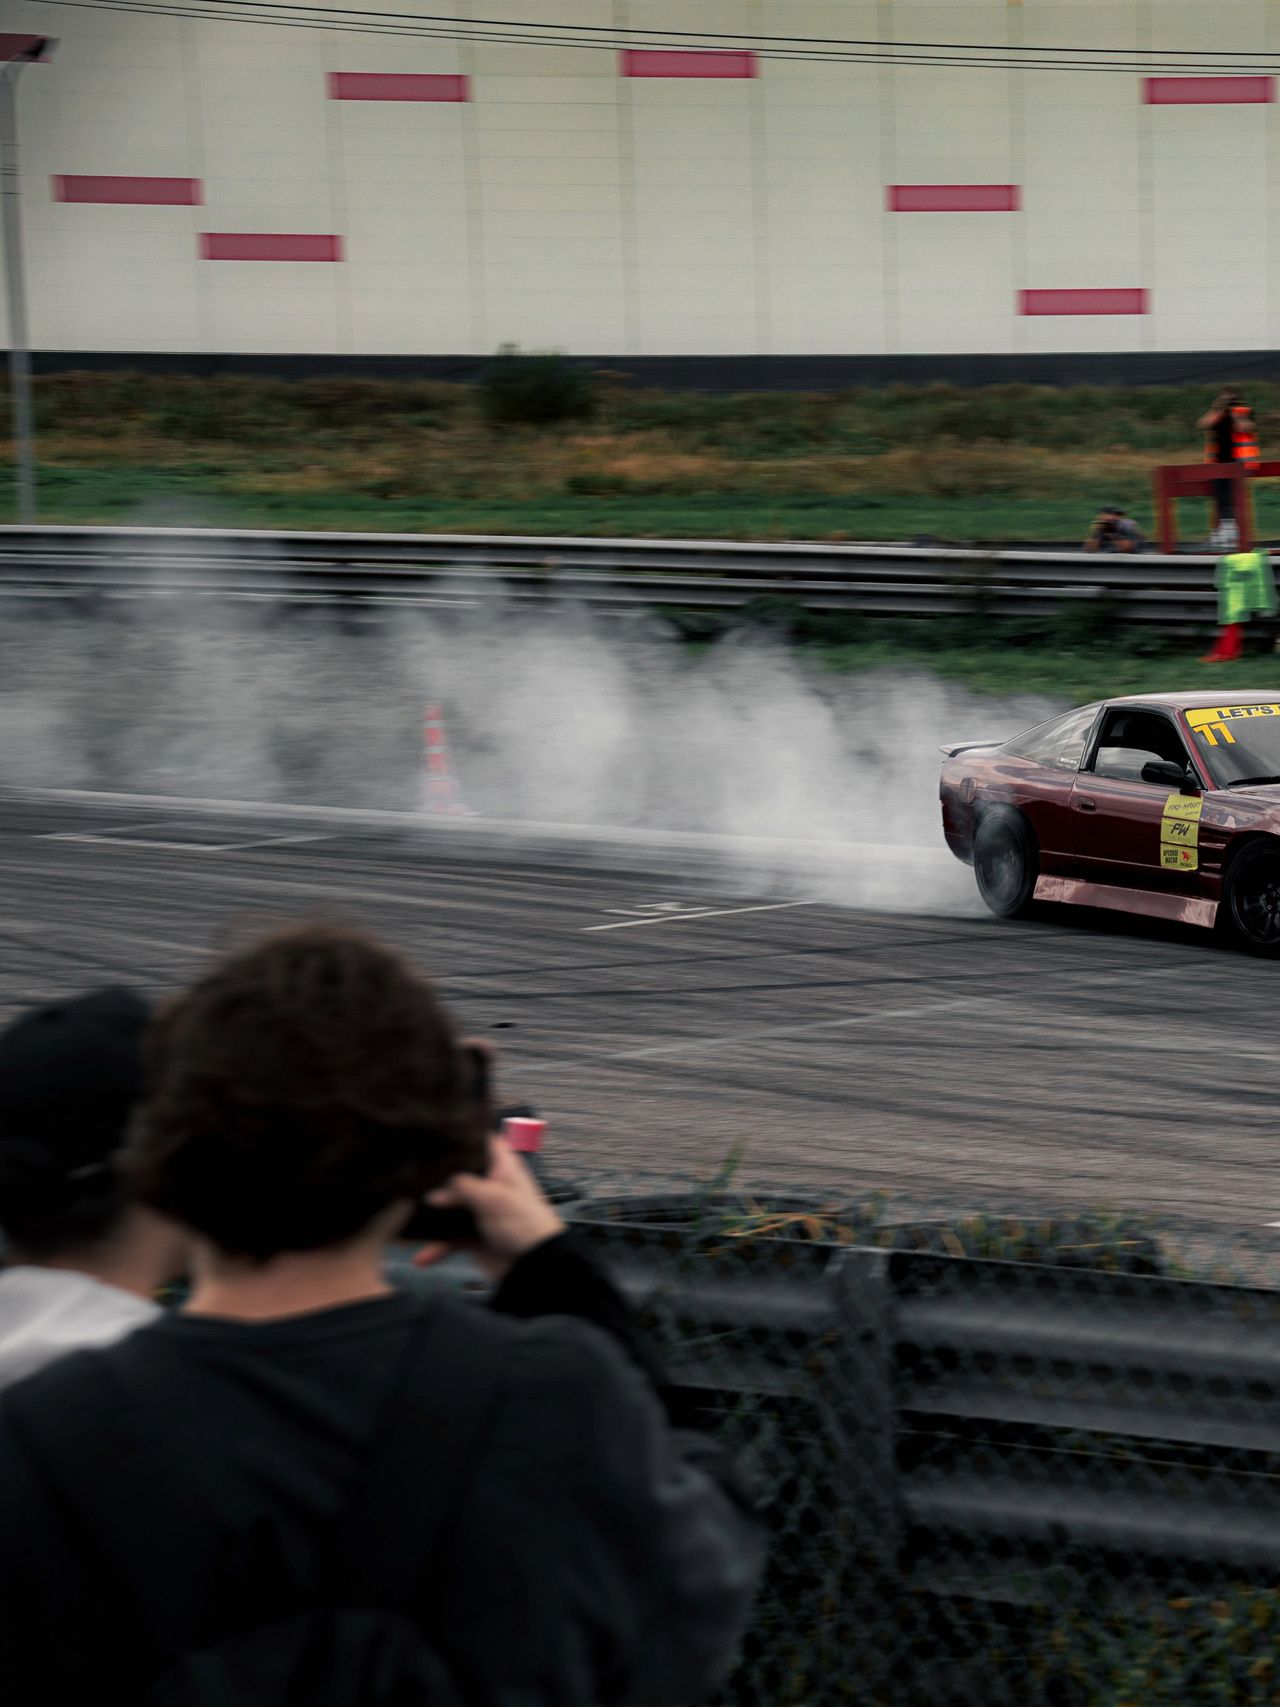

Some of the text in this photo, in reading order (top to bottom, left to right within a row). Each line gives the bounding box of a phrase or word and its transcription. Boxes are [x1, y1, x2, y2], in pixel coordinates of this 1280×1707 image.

[1217, 705, 1274, 720] LET'S
[1193, 722, 1236, 745] 11
[1170, 823, 1190, 835] PW
